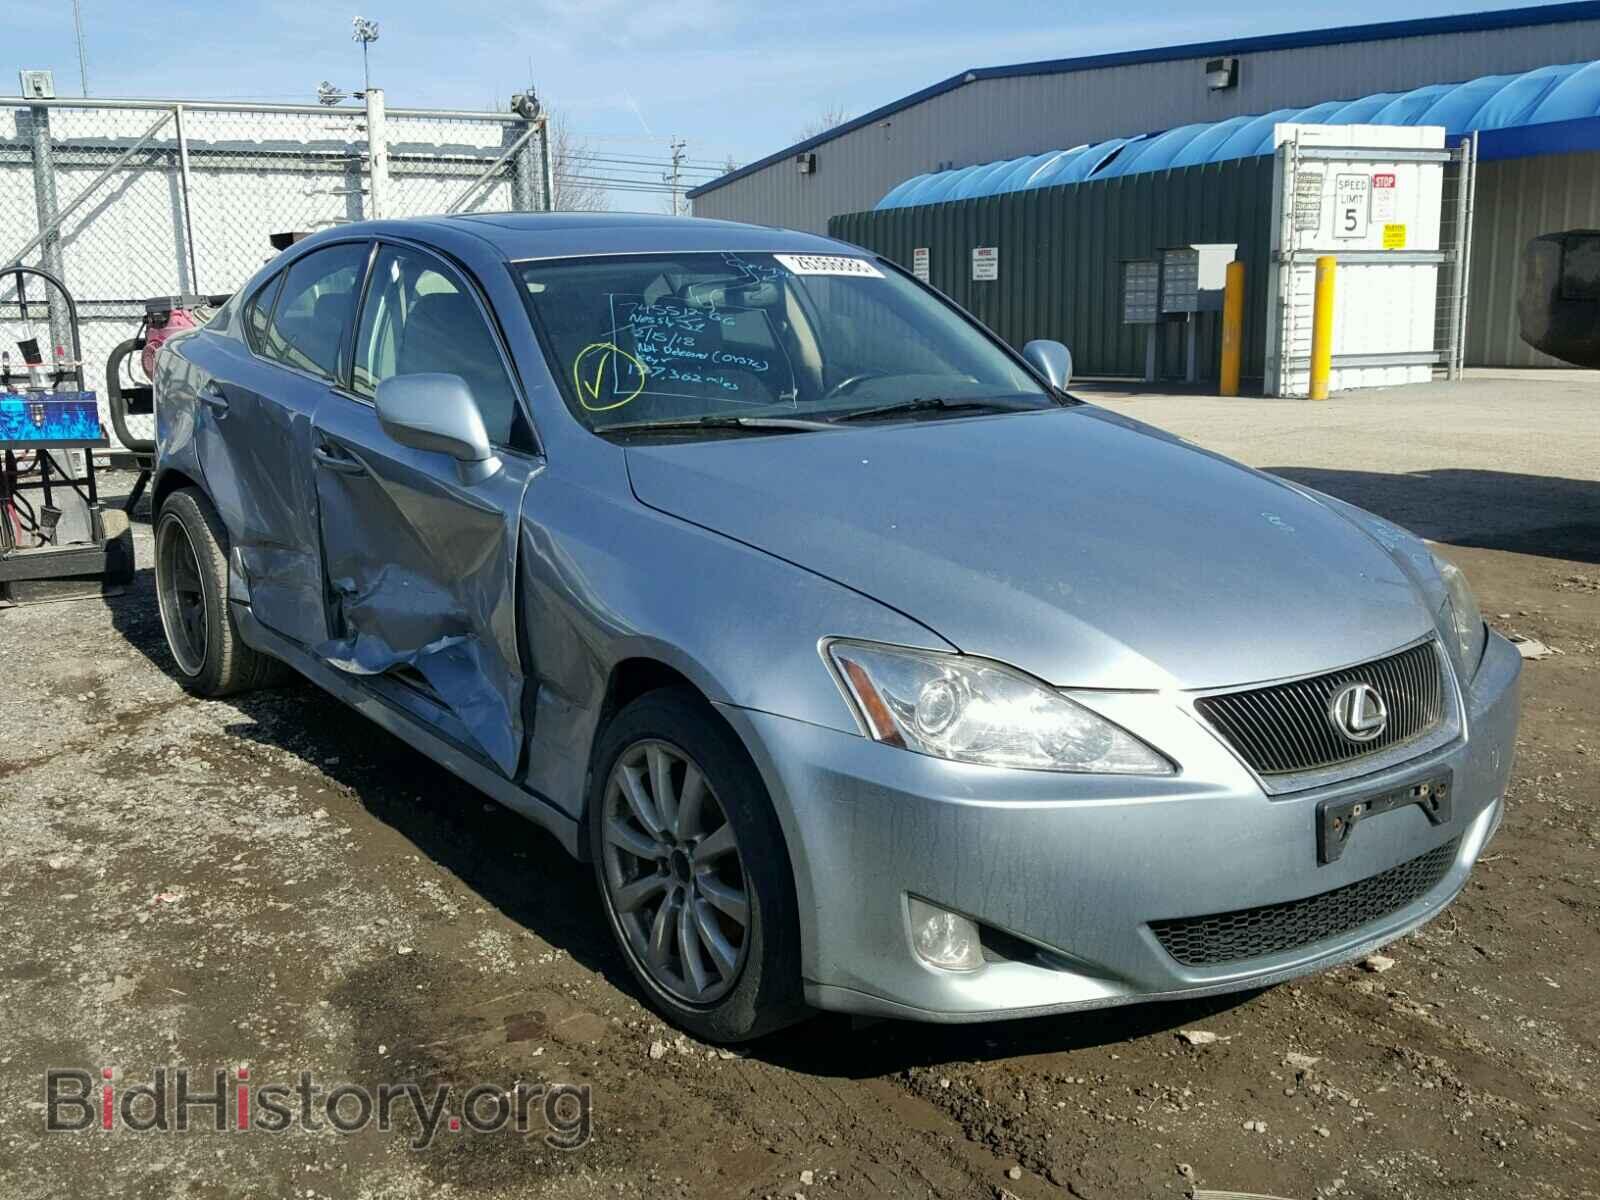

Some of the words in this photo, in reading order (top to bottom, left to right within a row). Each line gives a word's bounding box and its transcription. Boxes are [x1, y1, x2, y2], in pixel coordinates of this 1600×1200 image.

[1338, 179, 1367, 191] SPEED
[1374, 175, 1395, 187] STOP
[1340, 194, 1364, 205] LIMIT
[1344, 208, 1358, 231] 5
